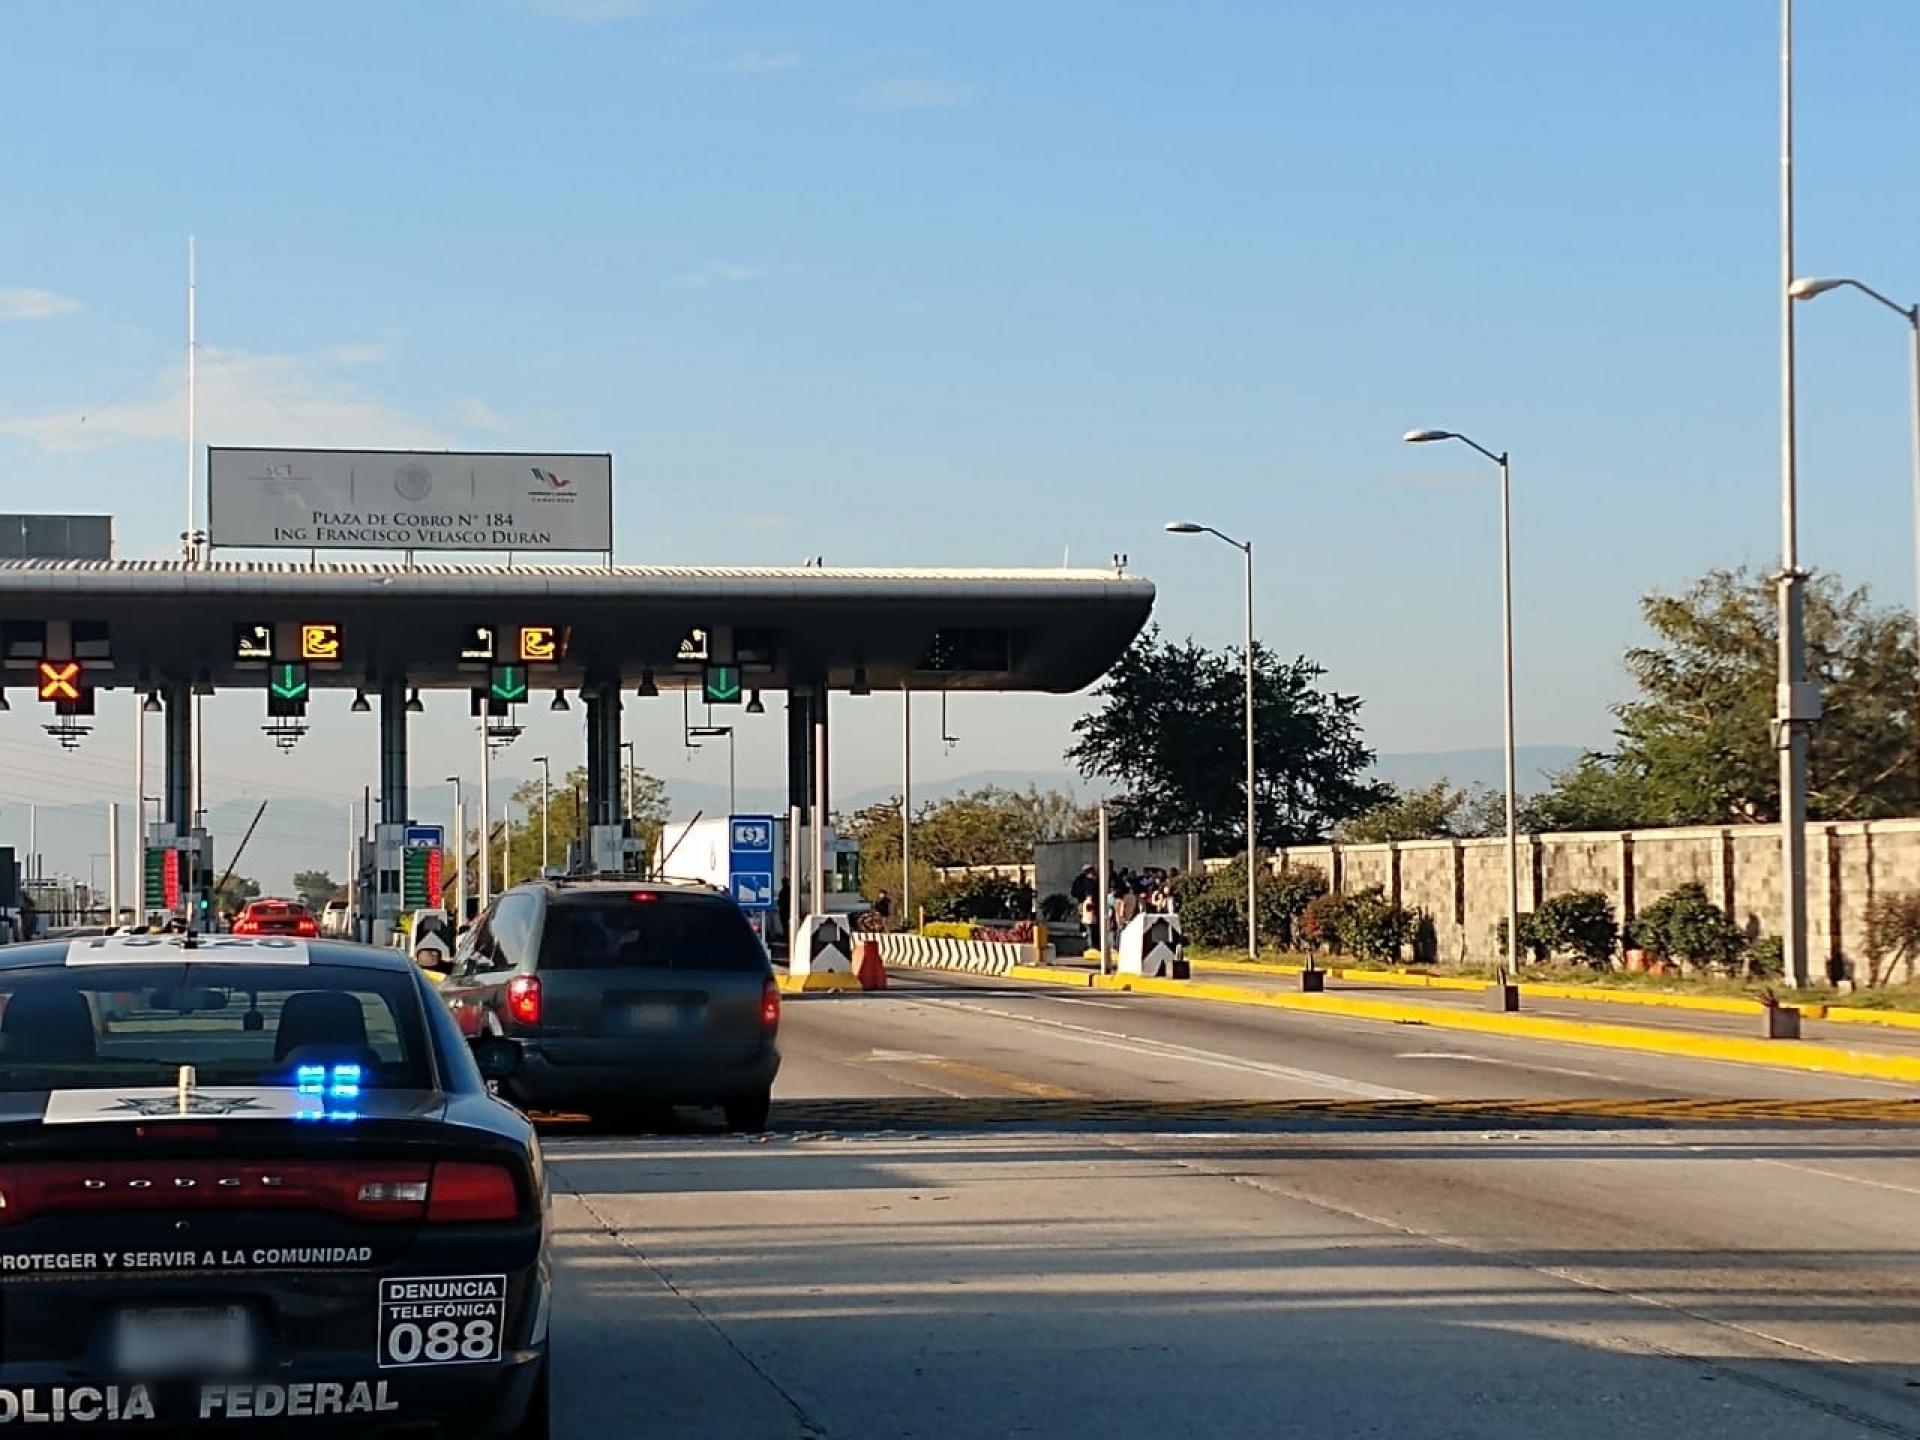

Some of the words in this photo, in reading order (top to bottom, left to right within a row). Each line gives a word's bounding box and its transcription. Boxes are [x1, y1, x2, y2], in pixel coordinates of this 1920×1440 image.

[312, 510, 362, 526] PLAZA
[368, 513, 389, 526] DE
[394, 513, 453, 527] COBRO
[485, 513, 513, 527] 184
[316, 527, 411, 541] FRANCISCO
[417, 528, 487, 543] VELASCO
[0, 1252, 97, 1271] ROTEGER
[103, 1252, 118, 1268] Y
[122, 1250, 196, 1268] SERVIR
[201, 1250, 216, 1266] A
[221, 1249, 247, 1266] LA
[252, 1247, 373, 1265] COMUNIDAD
[389, 1280, 498, 1300] DENUNCIA
[389, 1302, 498, 1320] TELEFÓNICA
[388, 1319, 494, 1363] 088
[198, 1379, 400, 1420] FEDERAL
